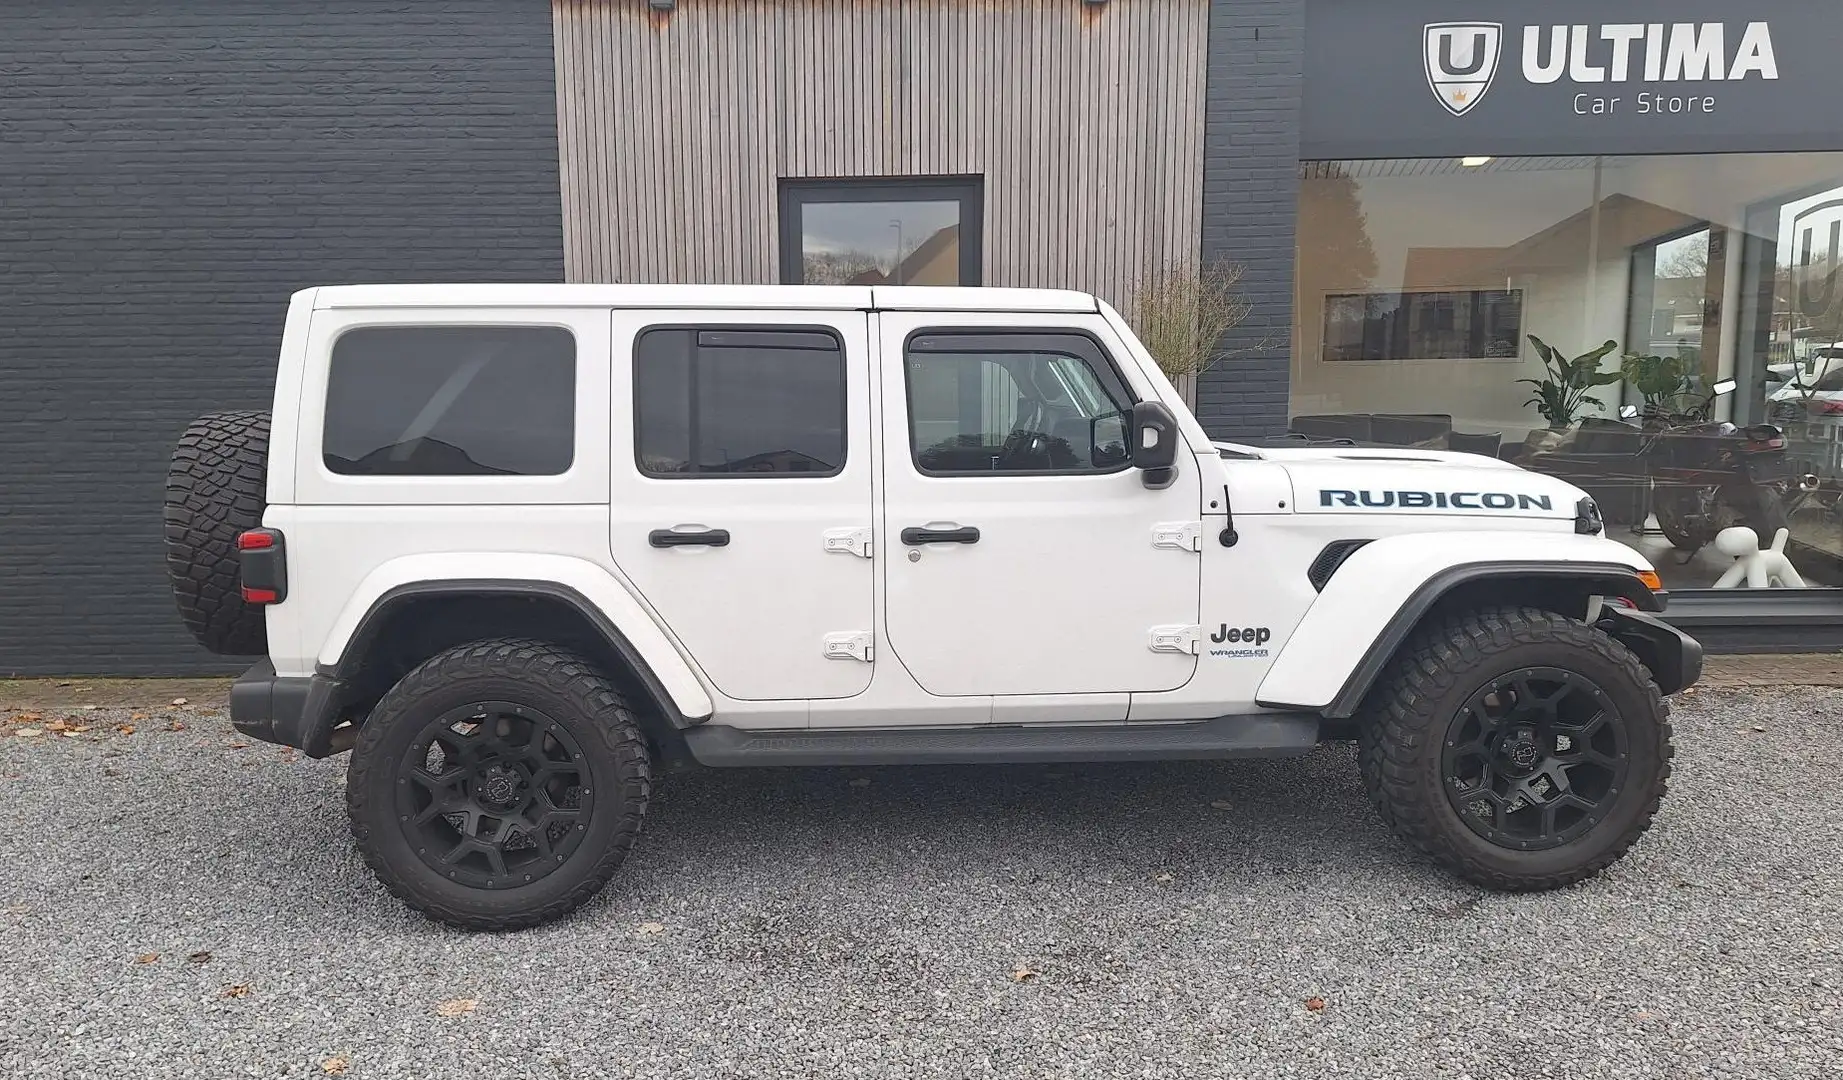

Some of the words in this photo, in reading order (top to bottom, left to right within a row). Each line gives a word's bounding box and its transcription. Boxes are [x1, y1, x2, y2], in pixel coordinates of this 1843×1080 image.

[1441, 34, 1487, 76] U
[1522, 22, 1779, 83] ULTIMA
[1573, 92, 1621, 114] Car
[1637, 92, 1716, 112] Store
[1319, 490, 1553, 511] RUBICON
[1211, 623, 1270, 646] Jeep
